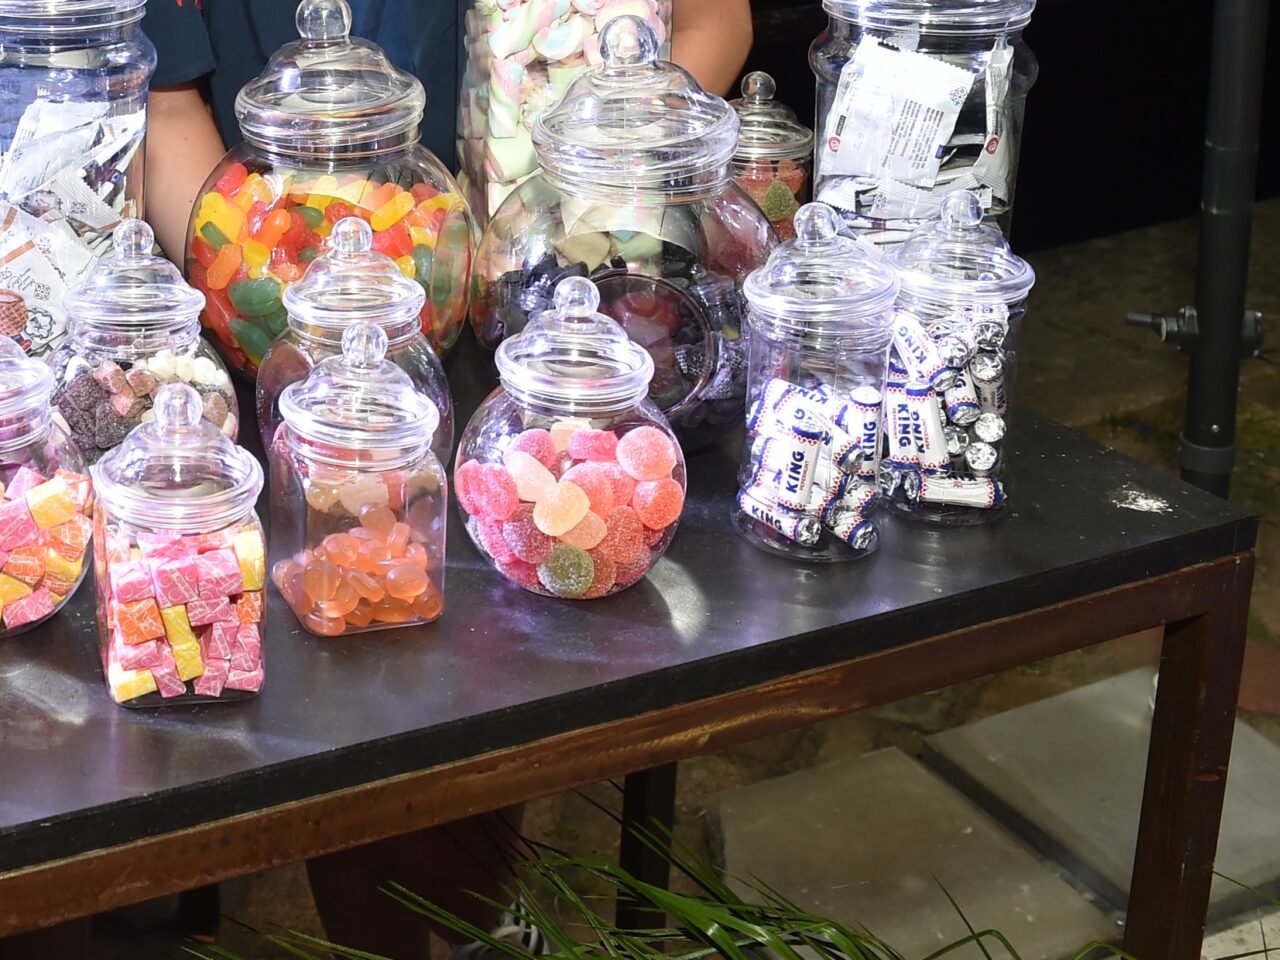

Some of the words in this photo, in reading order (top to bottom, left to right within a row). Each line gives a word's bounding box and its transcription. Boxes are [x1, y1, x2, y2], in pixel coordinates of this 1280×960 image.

[898, 325, 928, 365] KING
[863, 420, 878, 462] KING
[898, 403, 912, 448] KING
[910, 410, 926, 454] KING
[785, 450, 806, 494] KING
[751, 504, 783, 532] KING
